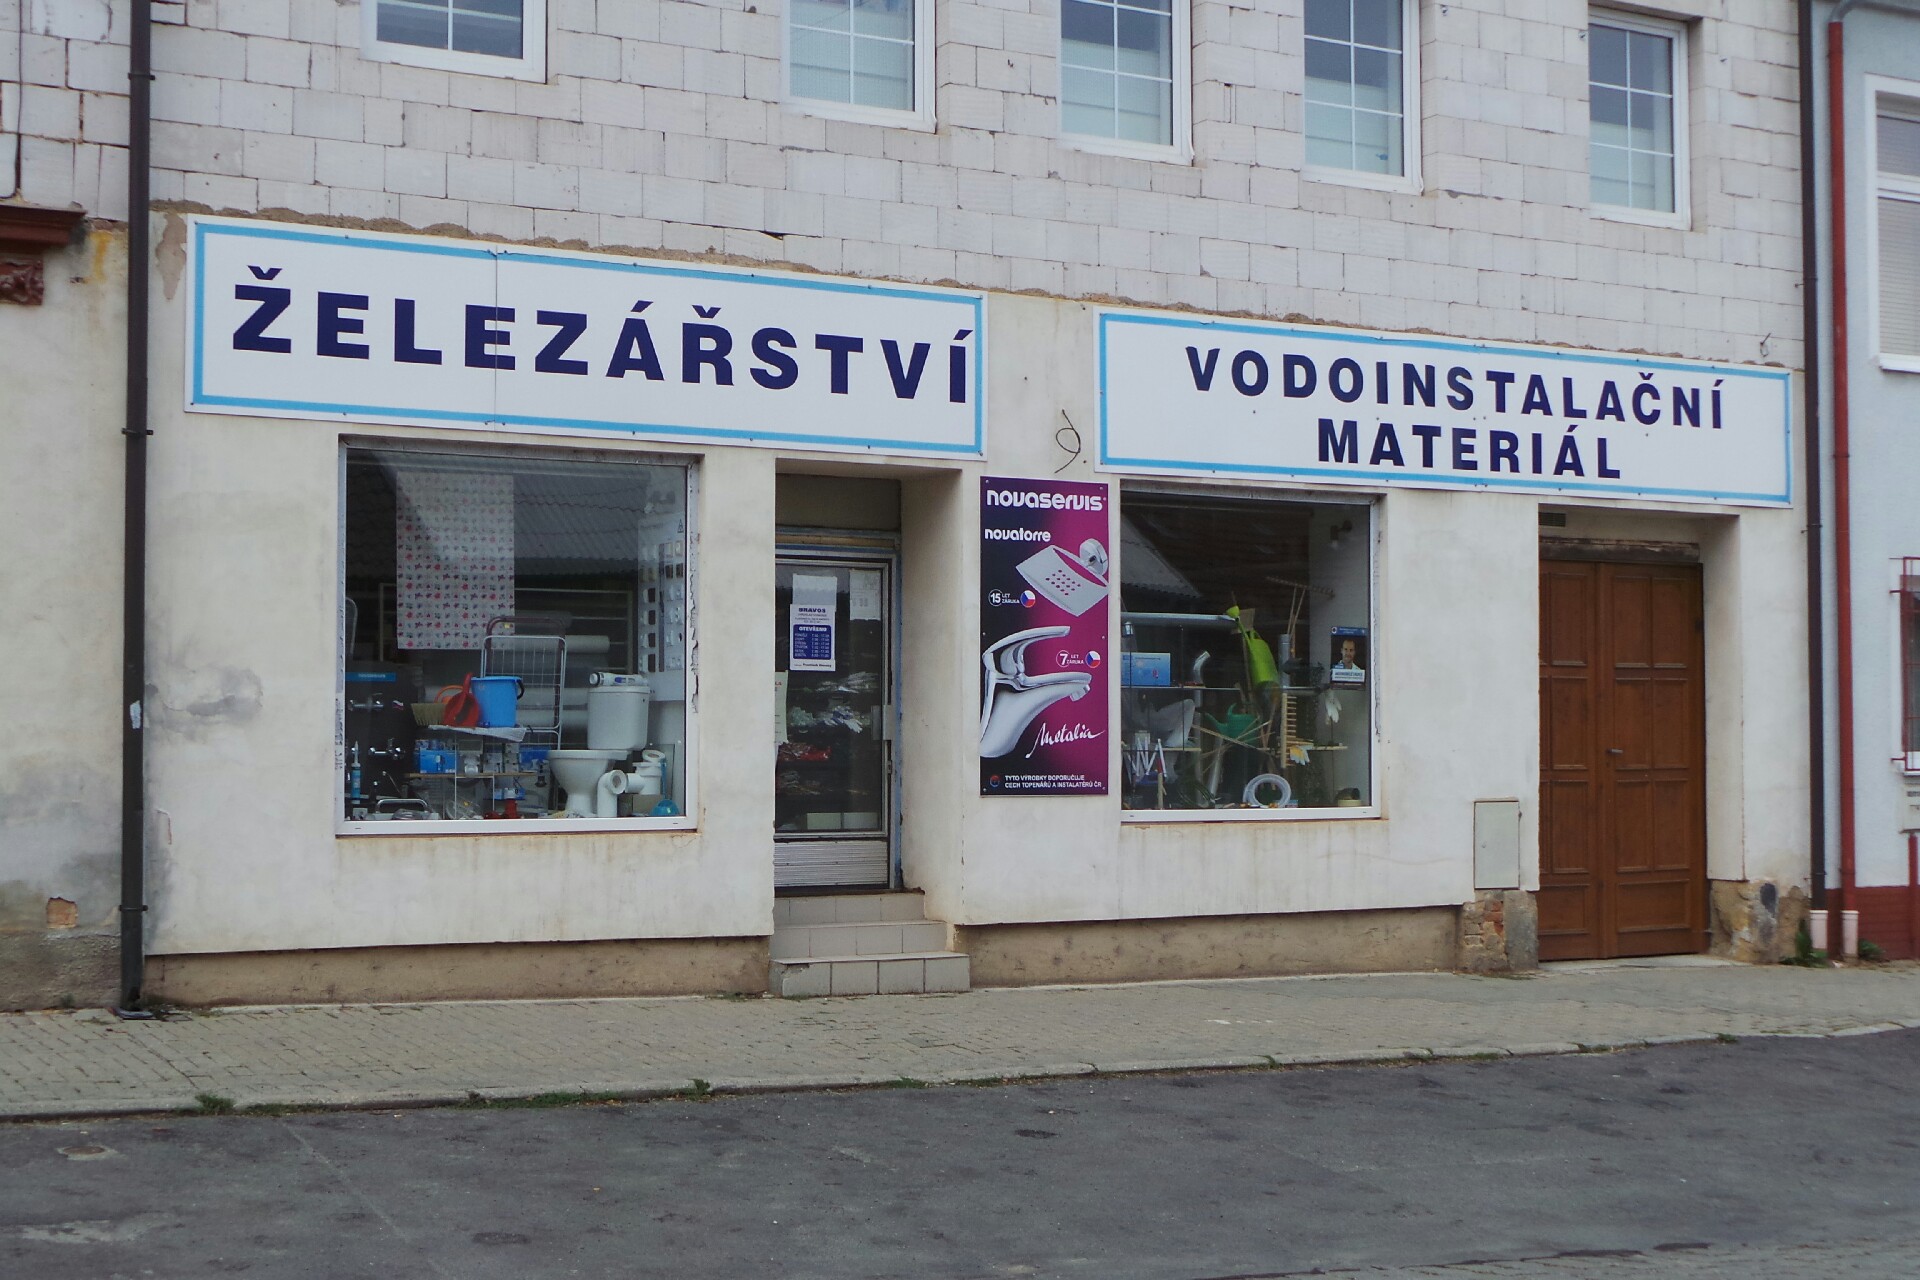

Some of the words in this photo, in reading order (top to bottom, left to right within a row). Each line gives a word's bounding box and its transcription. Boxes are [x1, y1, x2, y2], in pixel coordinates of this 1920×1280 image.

[232, 264, 974, 404] ŽELEZÁŘSTVÍ
[1185, 345, 1725, 430] VODOINSTALAČNÍ
[1317, 417, 1622, 480] MATERIÁL
[986, 489, 1103, 511] novaservis
[984, 527, 1052, 542] novatorre
[990, 592, 1001, 604] 15
[1059, 653, 1069, 666] 7
[1025, 722, 1106, 759] Metalia
[1094, 780, 1102, 788] ČR
